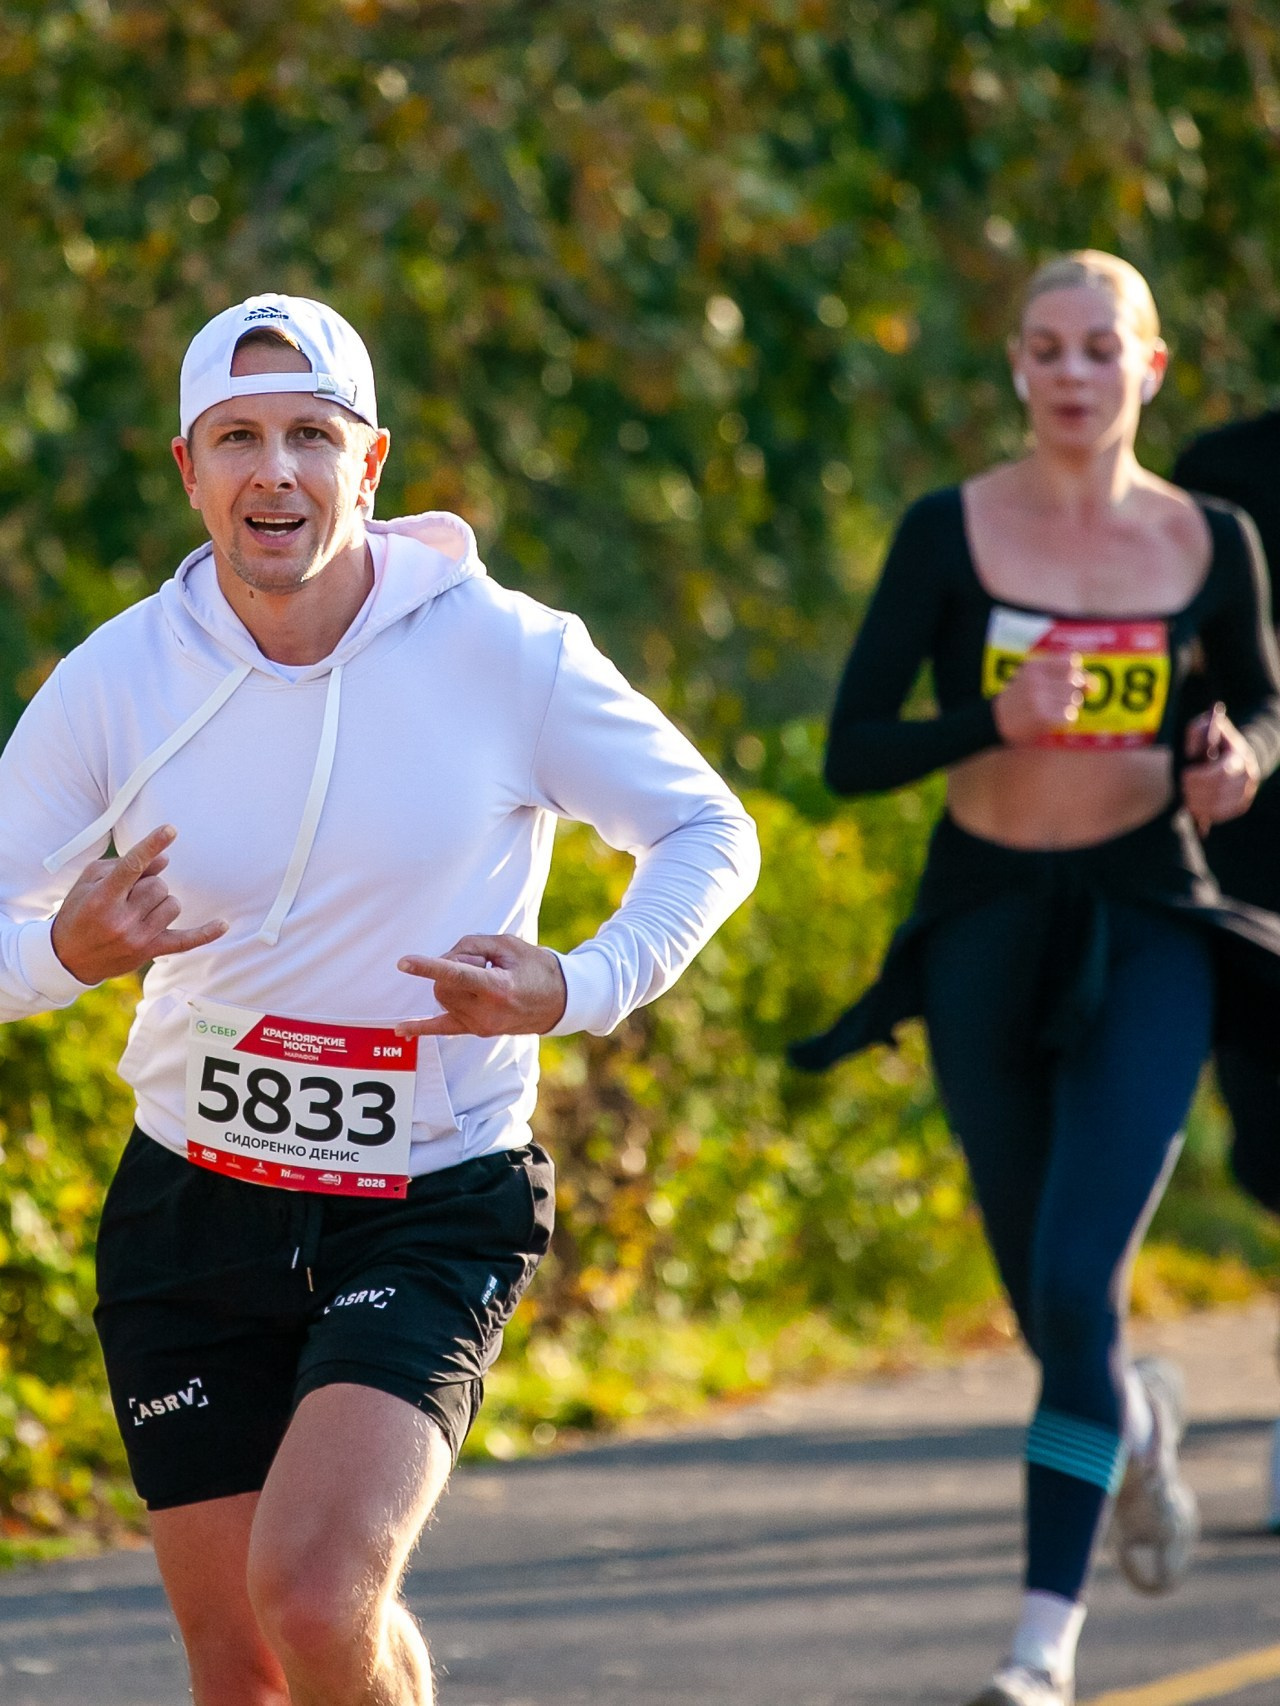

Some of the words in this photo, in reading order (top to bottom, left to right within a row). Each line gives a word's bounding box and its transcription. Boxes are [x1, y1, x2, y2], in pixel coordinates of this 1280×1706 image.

[210, 1024, 237, 1038] СБЕР
[262, 1026, 346, 1047] КРАСНОЯРСКИЕ
[283, 1040, 322, 1054] МОСТЫ
[373, 1046, 381, 1057] 5
[198, 1055, 396, 1147] 5833
[224, 1131, 307, 1157] СИДОРЕНКО
[309, 1148, 360, 1163] ДЕНИС
[357, 1178, 386, 1188] 2026
[139, 1387, 193, 1419] ASRV
